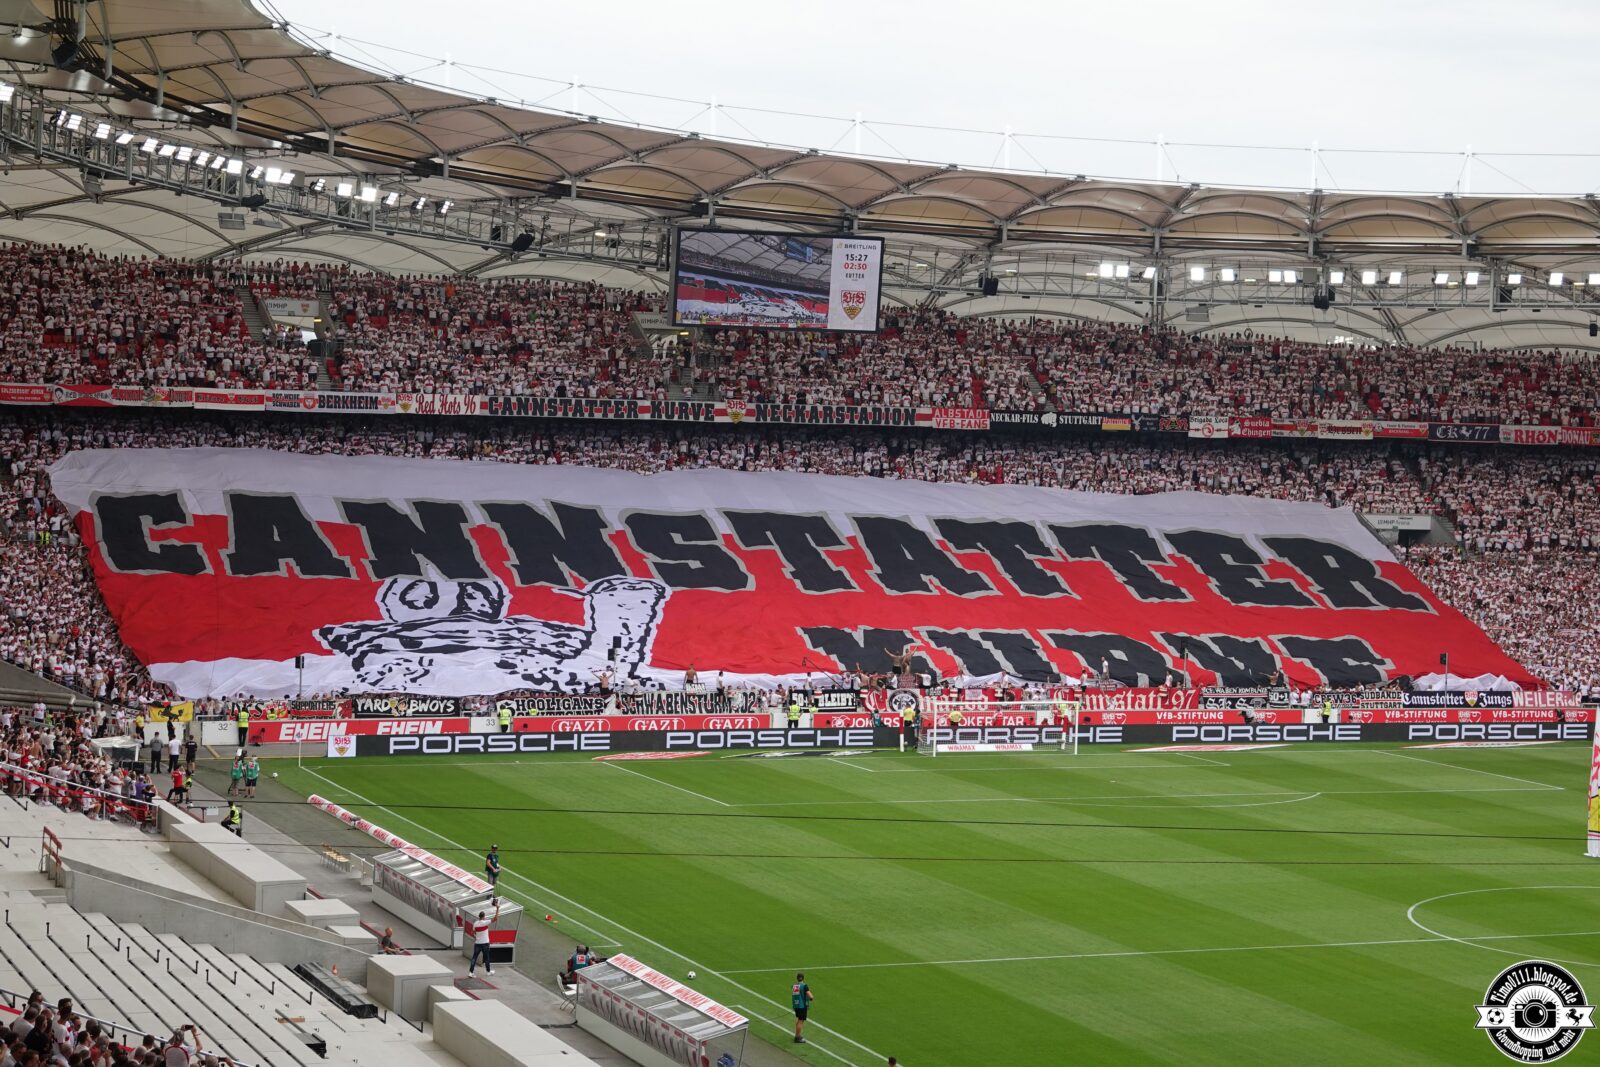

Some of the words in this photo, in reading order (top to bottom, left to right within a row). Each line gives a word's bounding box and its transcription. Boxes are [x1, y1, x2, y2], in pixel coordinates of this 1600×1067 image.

[844, 262, 867, 270] 02:30
[318, 394, 378, 410] BERKHEIM
[415, 394, 435, 414] Red
[438, 394, 461, 414] Hots
[464, 394, 476, 414] 96
[488, 396, 638, 418] CANNSTATTER
[650, 400, 714, 421] KURVE
[755, 404, 916, 426] NECKARSTADION
[934, 408, 990, 418] ALBSTADT
[990, 412, 1039, 424] NECKAR-FILS
[1058, 414, 1102, 425] STUTTGART
[935, 419, 988, 428] VFB-FANS
[1474, 426, 1490, 439] 77
[1562, 429, 1590, 444] DONAU
[92, 489, 1438, 614] CANNSTATTER
[356, 700, 390, 712] YARD
[410, 700, 455, 712] BWOYS
[515, 697, 605, 711] HOOLIGANS
[1172, 690, 1196, 710] 97
[1403, 692, 1464, 706] Cannstatter
[1478, 692, 1512, 707] Jungs
[279, 722, 347, 740] EHEIM
[666, 730, 874, 748] PORSCHE
[927, 727, 1123, 744] PORSCHE
[1172, 725, 1361, 742] PORSCHE
[1408, 724, 1588, 740] PORSCHE
[389, 733, 610, 754] PORSCHE
